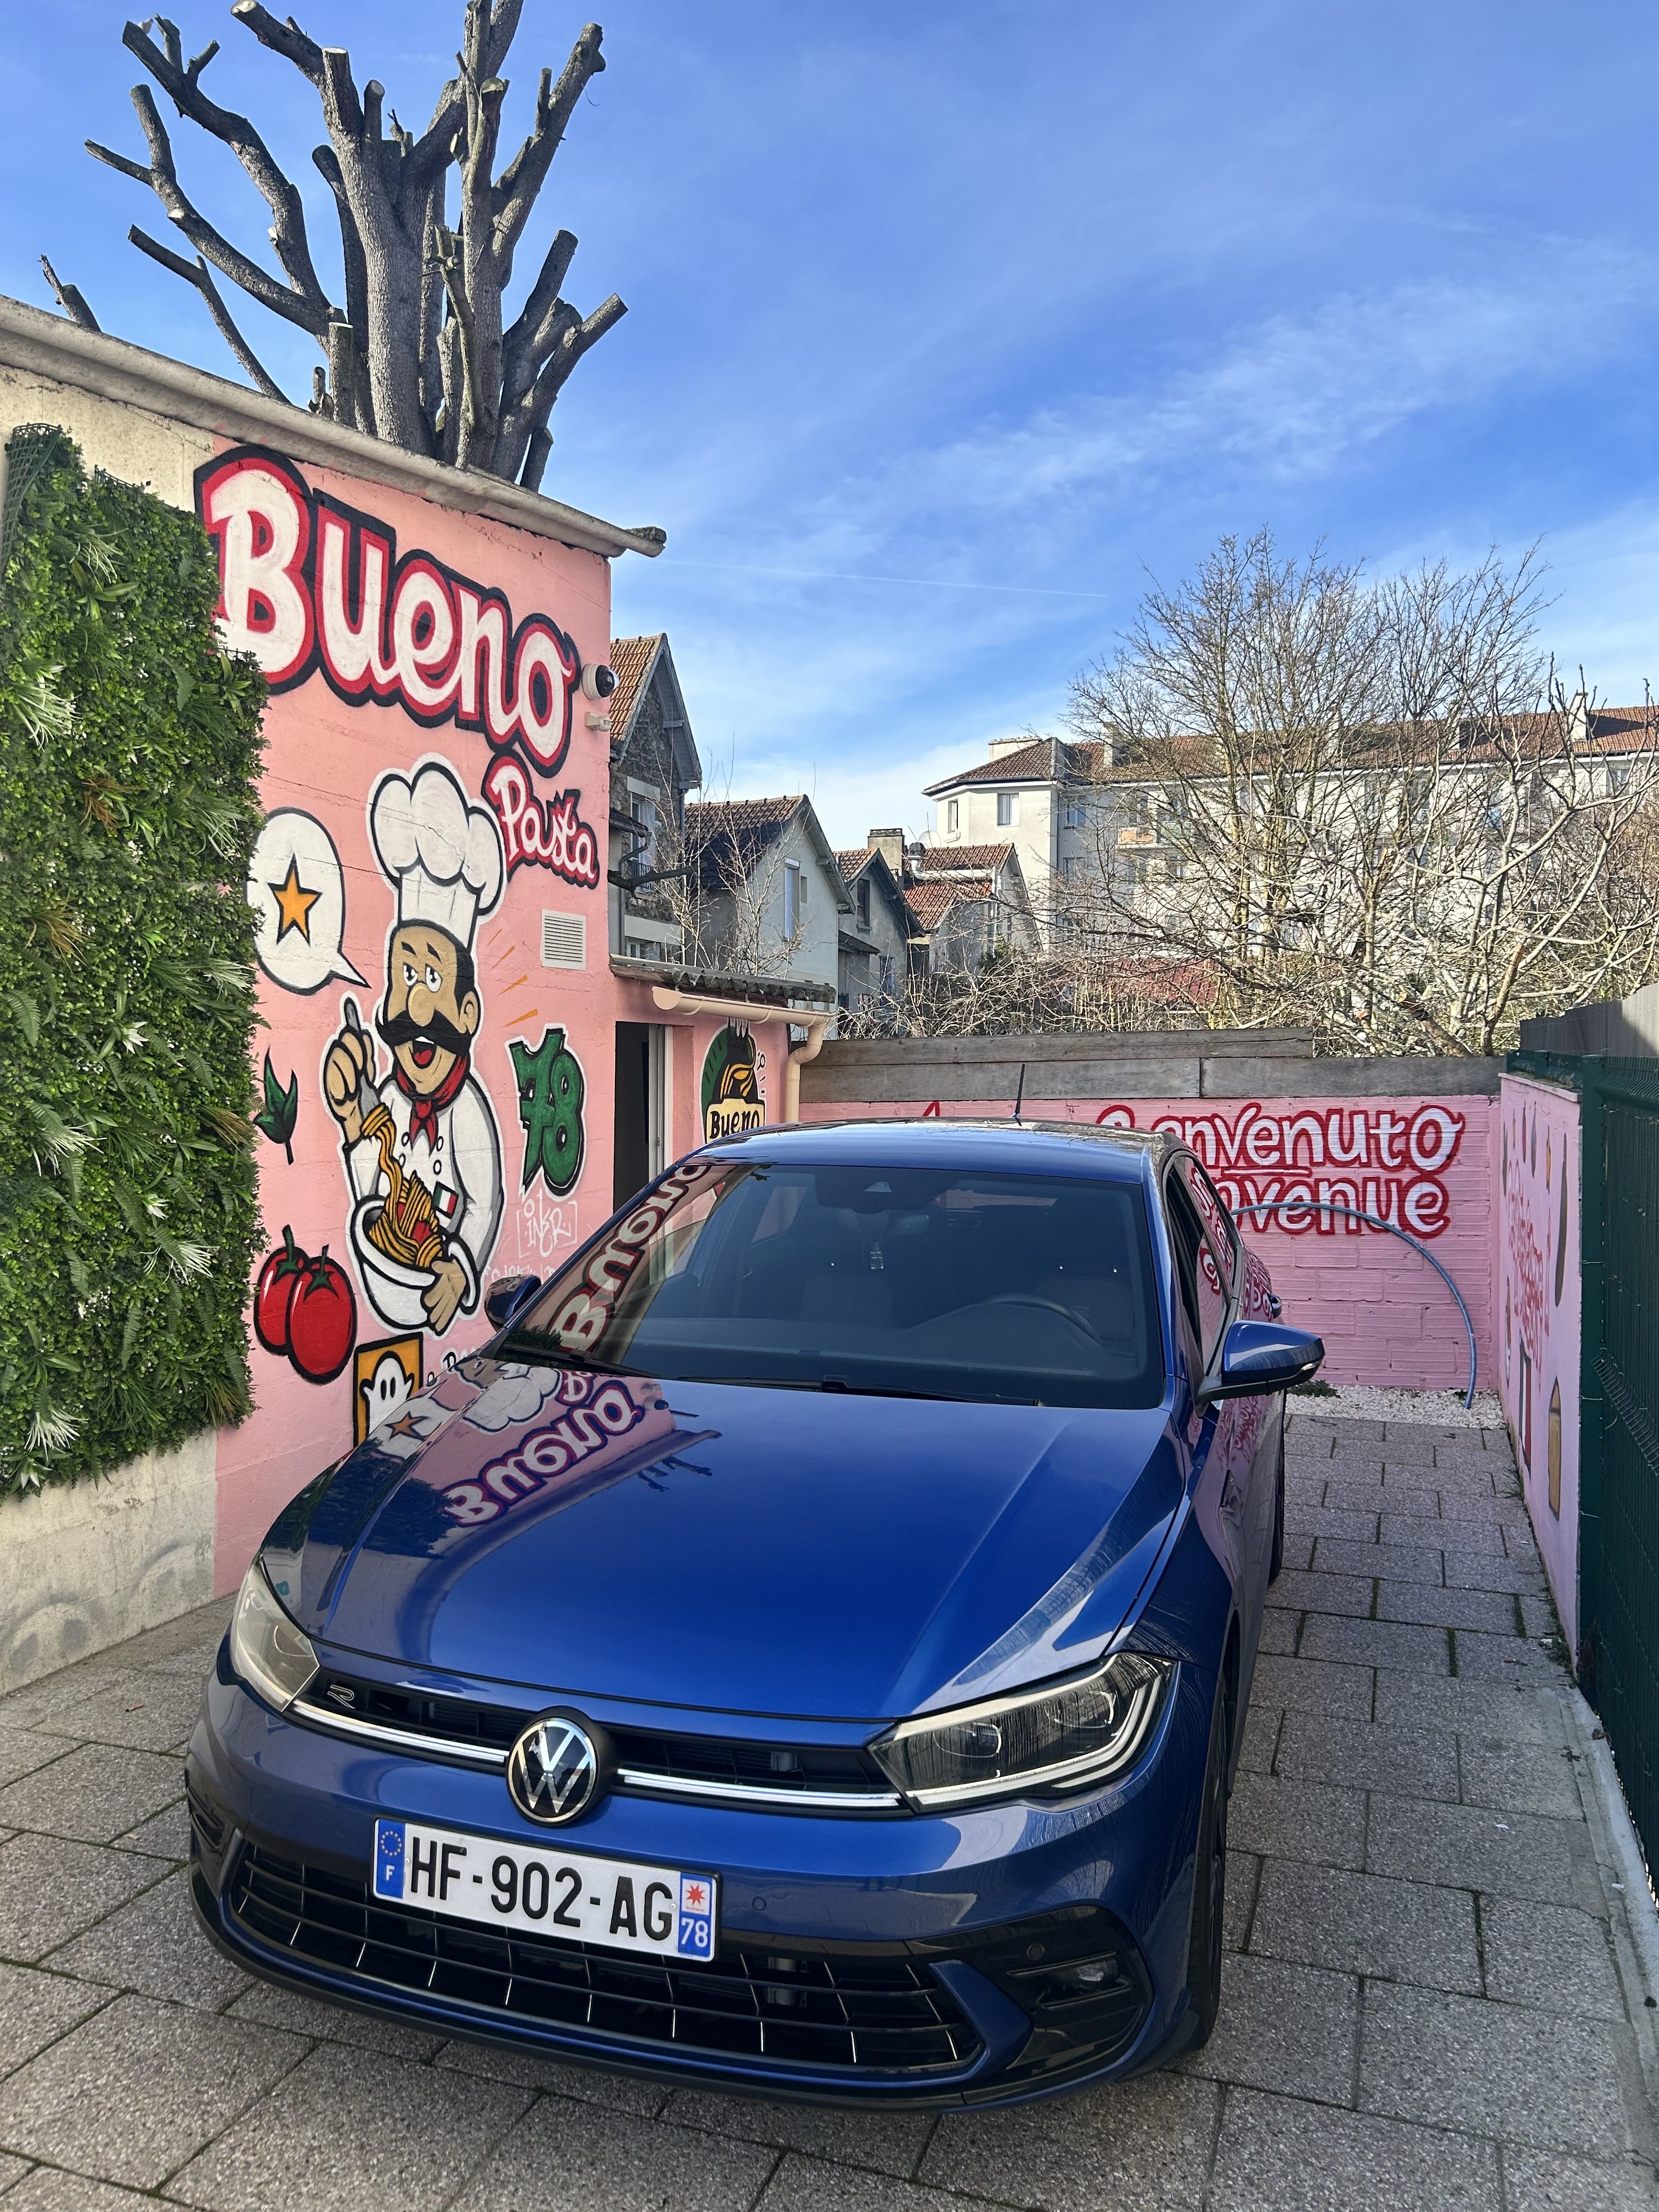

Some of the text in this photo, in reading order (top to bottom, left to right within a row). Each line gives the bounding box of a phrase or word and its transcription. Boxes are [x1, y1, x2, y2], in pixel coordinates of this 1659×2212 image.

[195, 447, 580, 776] Bueno
[483, 753, 599, 888] Pasta
[509, 1028, 584, 1195] 78
[709, 1110, 760, 1139] Bueno
[386, 1865, 394, 1882] F
[410, 1836, 673, 1942] HF-902-AG
[681, 1917, 708, 1947] 78
